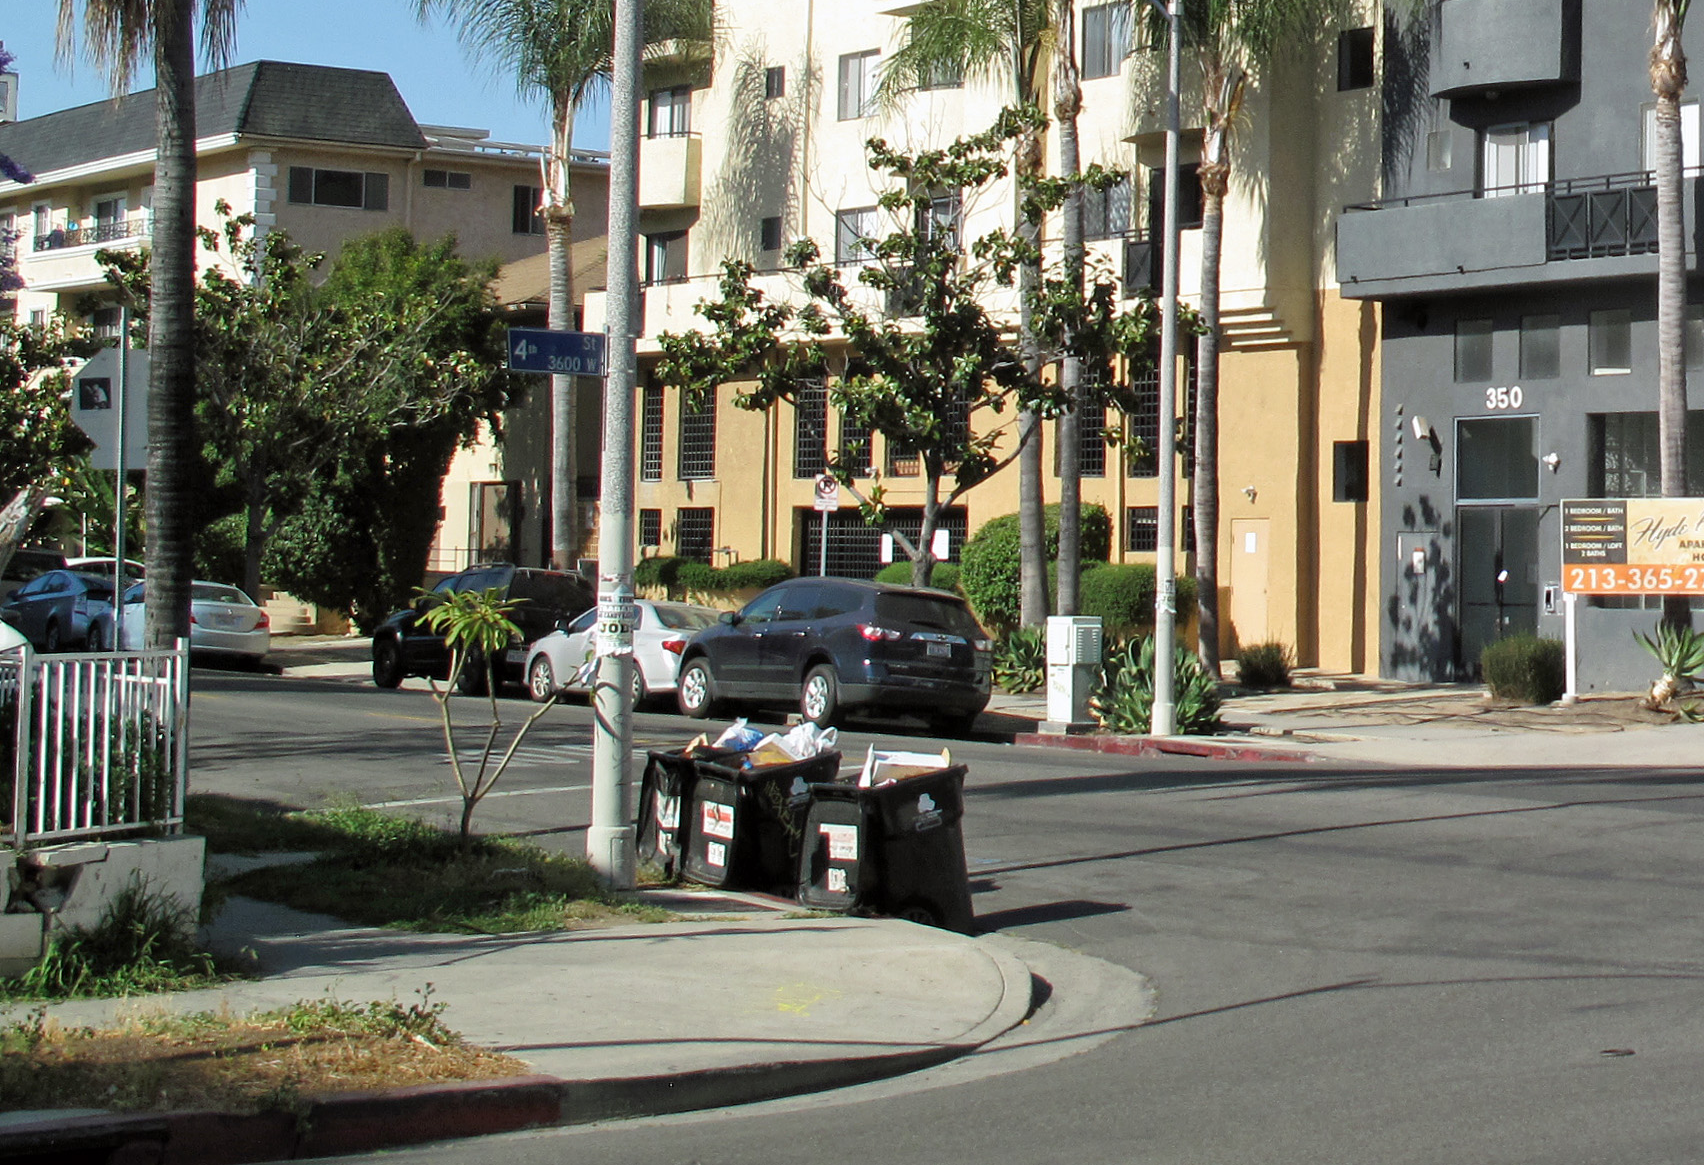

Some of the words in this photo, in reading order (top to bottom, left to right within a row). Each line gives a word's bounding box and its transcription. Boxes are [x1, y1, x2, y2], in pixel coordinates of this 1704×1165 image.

[514, 338, 538, 361] 4th
[583, 336, 597, 351] St
[547, 355, 581, 372] 3600
[586, 357, 597, 372] W
[1486, 386, 1523, 409] 350
[1630, 516, 1688, 550] Hyde
[1570, 542, 1602, 550] BEDROOM
